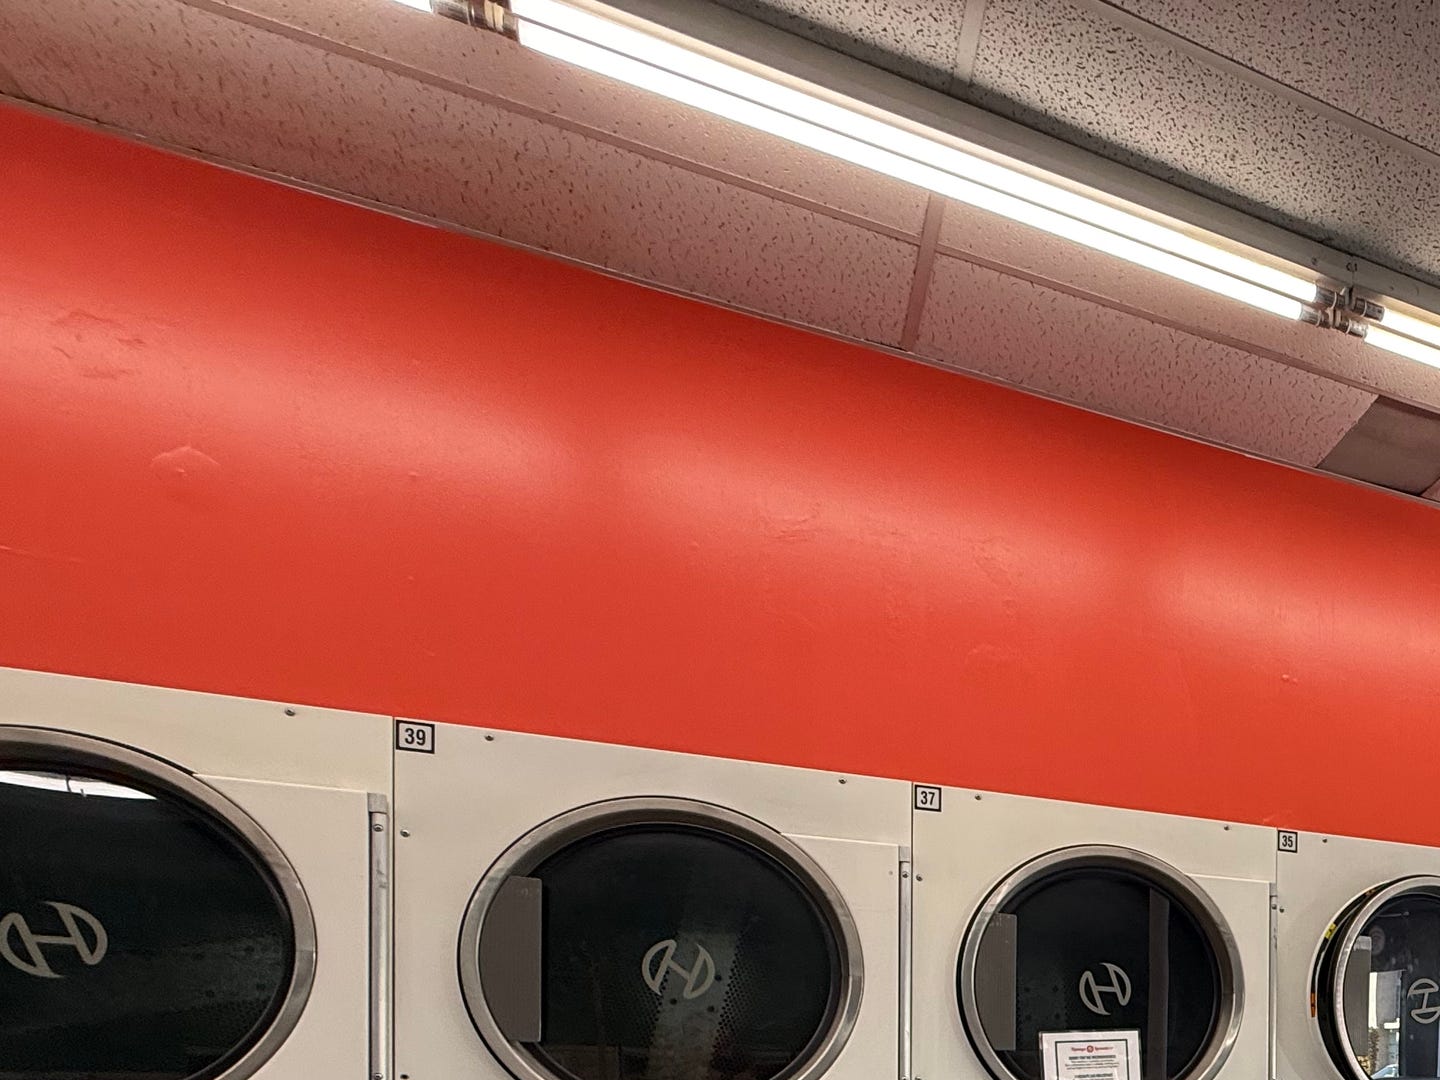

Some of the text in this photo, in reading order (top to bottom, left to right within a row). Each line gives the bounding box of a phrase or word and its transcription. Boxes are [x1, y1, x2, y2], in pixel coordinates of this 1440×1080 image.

[404, 728, 426, 746] 39
[920, 791, 935, 806] 37
[1282, 834, 1294, 848] 35
